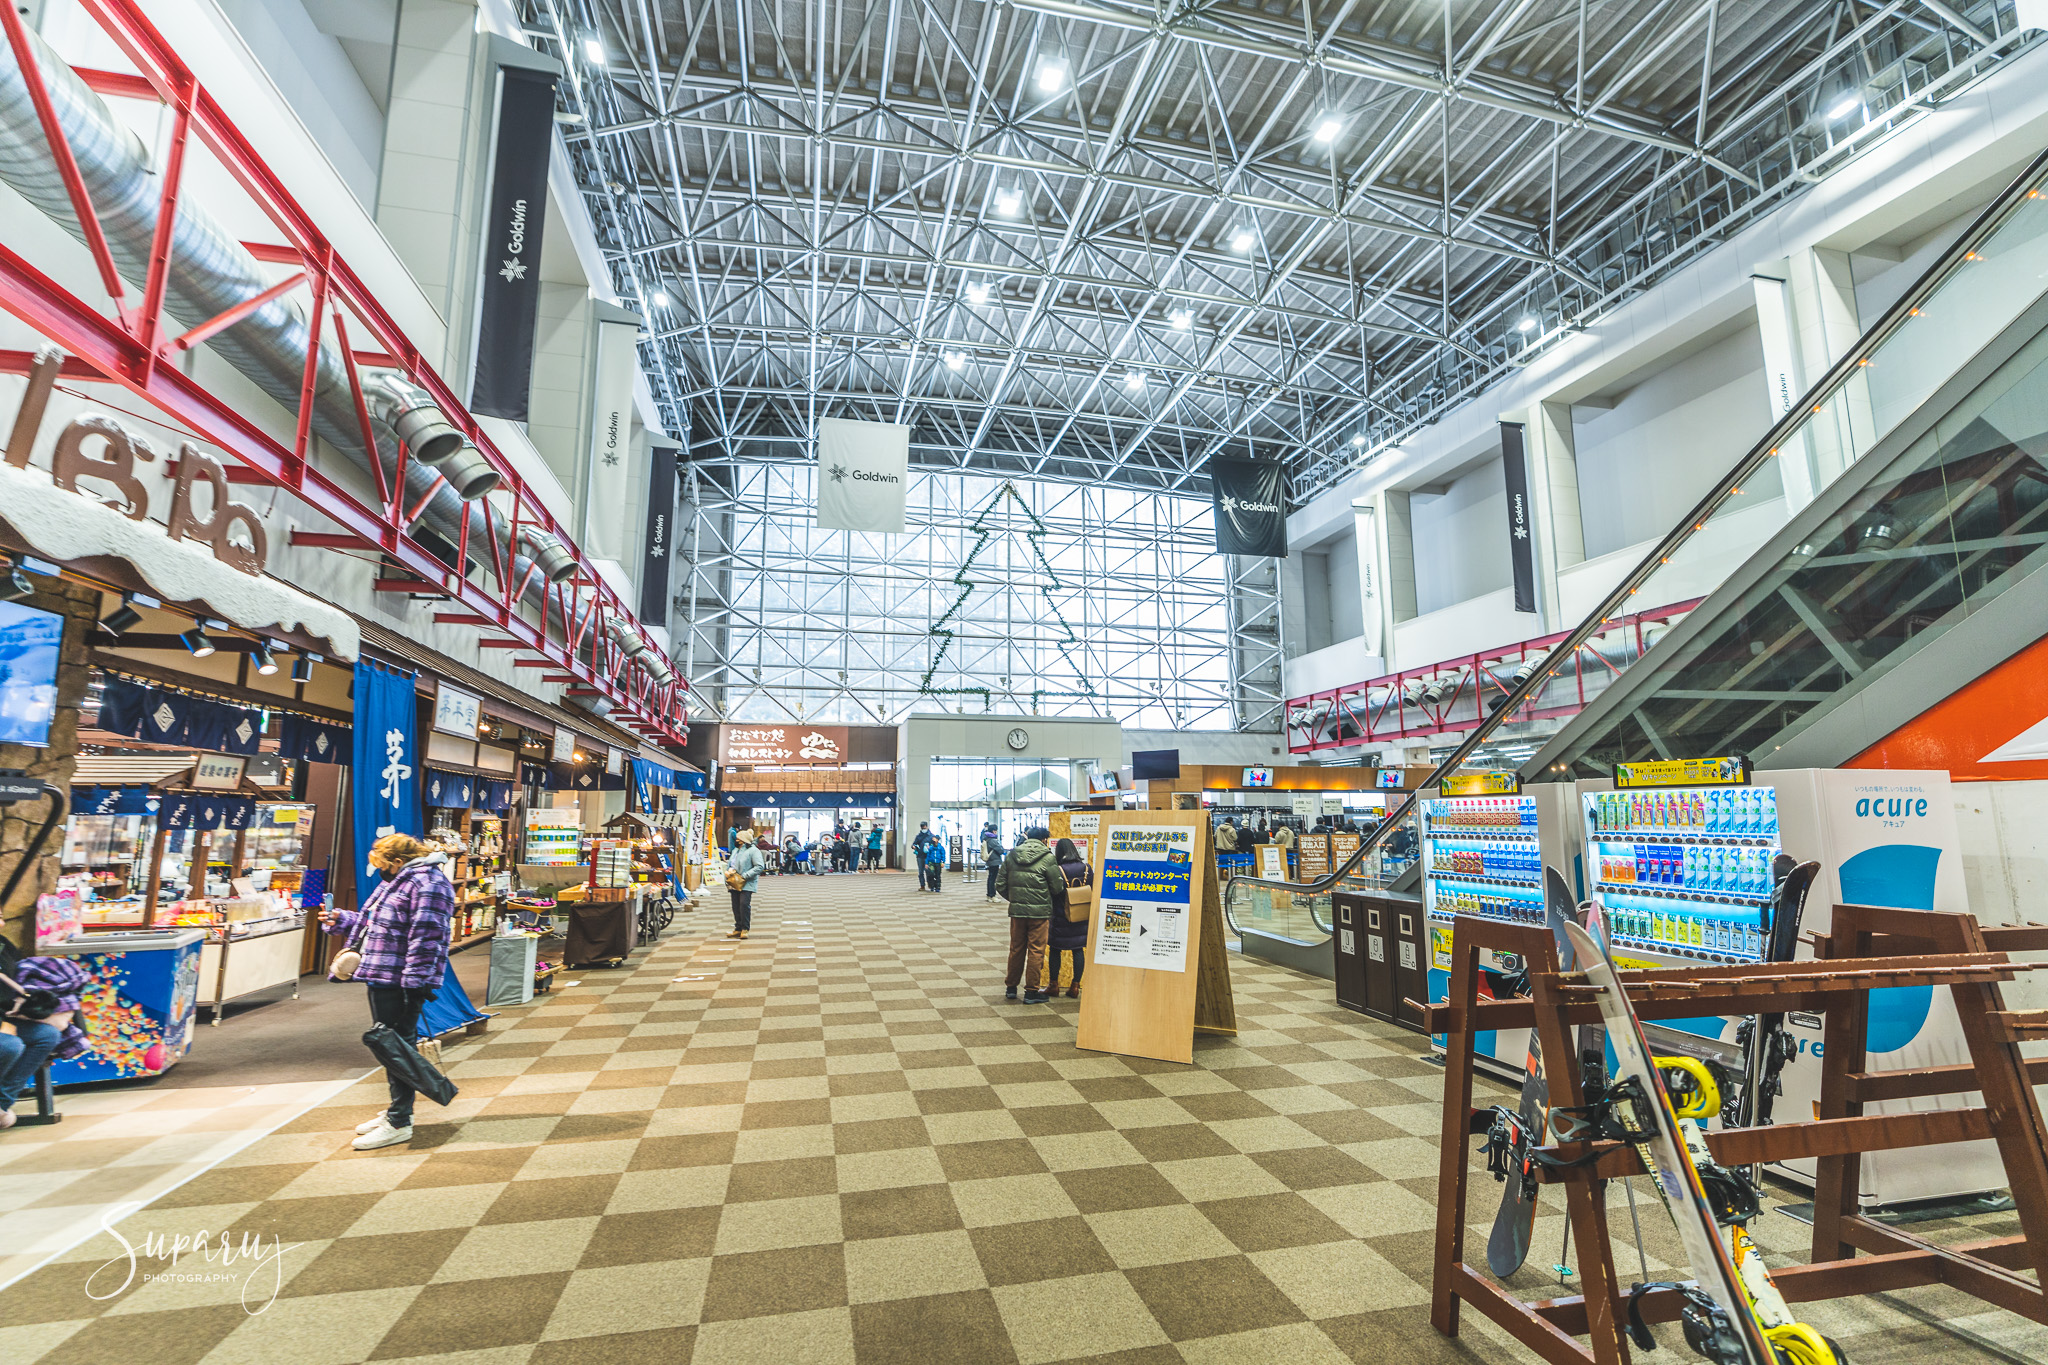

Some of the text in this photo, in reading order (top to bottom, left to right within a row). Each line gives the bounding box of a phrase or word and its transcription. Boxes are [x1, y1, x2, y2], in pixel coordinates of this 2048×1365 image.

[508, 198, 527, 255] Goldwin
[607, 411, 619, 449] Goldwin
[852, 469, 899, 484] Goldwin
[1240, 500, 1279, 513] Goldwin
[654, 513, 664, 544] Goldwin
[729, 728, 785, 742] おむすび処
[728, 747, 793, 759] 和食レストラン
[1855, 797, 1928, 818] acure
[1883, 820, 1905, 828] アキュア
[1112, 831, 1129, 841] ONI
[1111, 842, 1168, 853] ご購入のお客様
[1105, 869, 1189, 881] 先にチケットカウンターで
[1114, 882, 1178, 893] 引き換えが必要です
